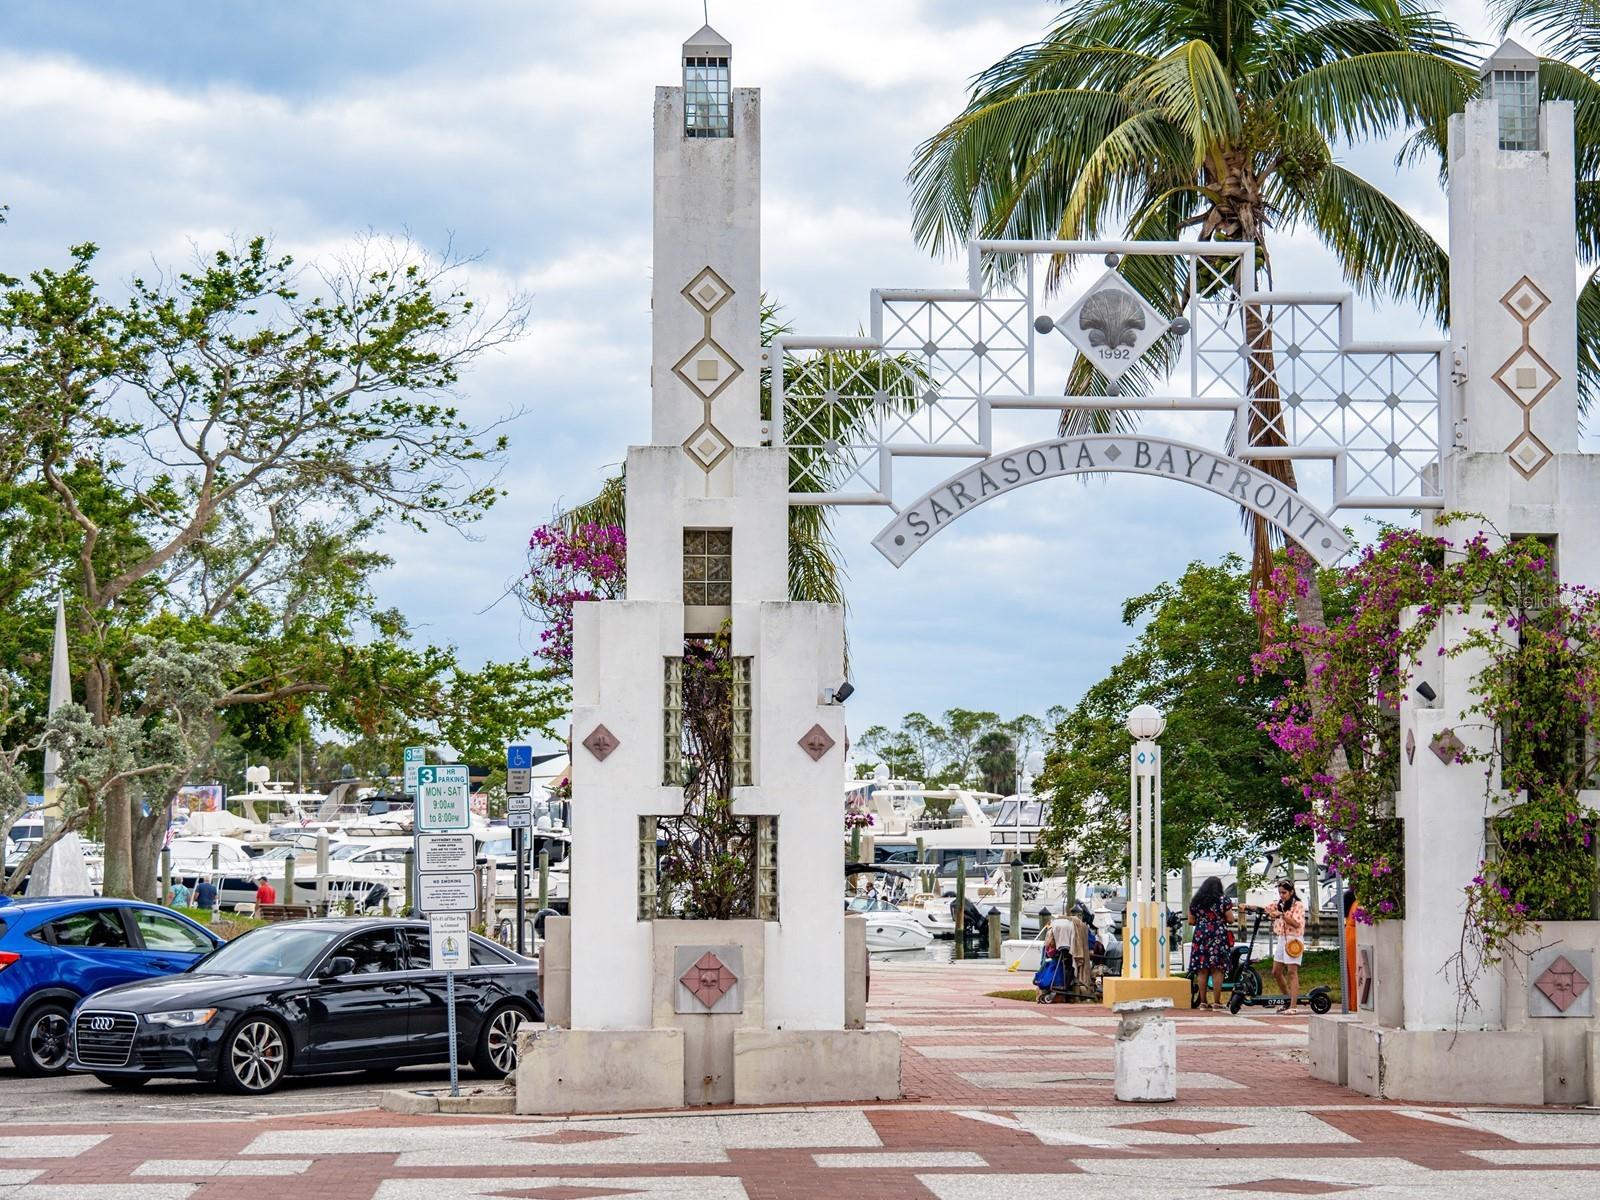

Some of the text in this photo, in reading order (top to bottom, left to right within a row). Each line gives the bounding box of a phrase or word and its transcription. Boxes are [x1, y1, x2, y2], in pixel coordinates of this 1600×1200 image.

[1098, 348, 1130, 360] 1992
[907, 441, 1326, 539] SARASOTA BAYFRONT
[406, 749, 412, 761] 3
[421, 769, 434, 783] 3
[425, 786, 442, 797] MON
[447, 786, 462, 797] SAT
[432, 800, 455, 810] 9:00AM
[429, 814, 437, 823] to
